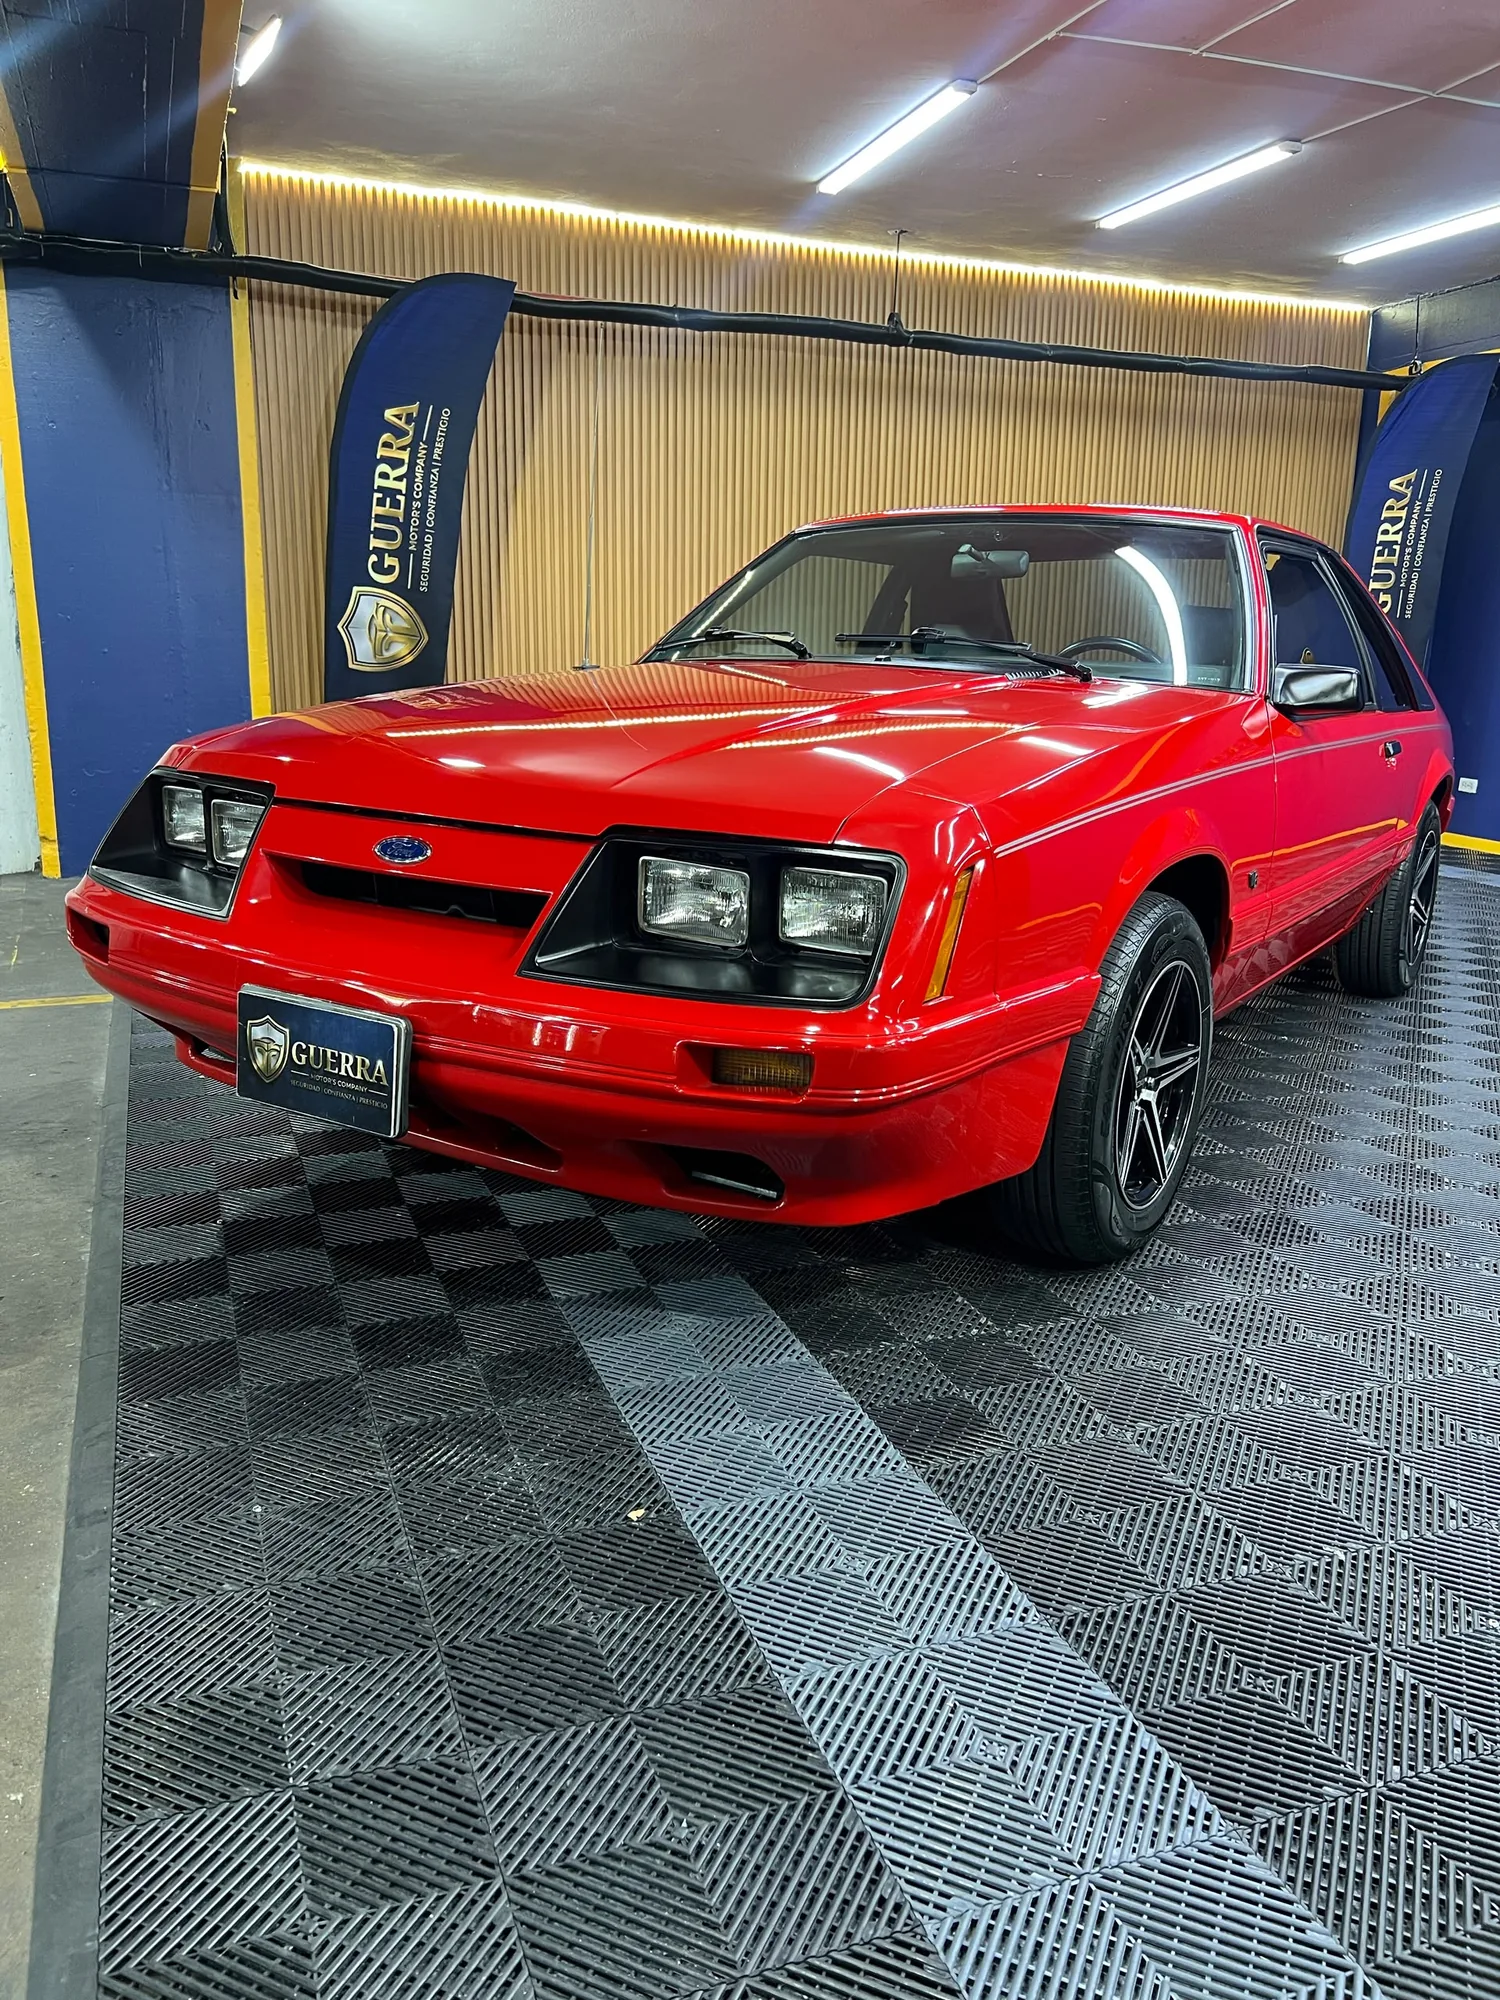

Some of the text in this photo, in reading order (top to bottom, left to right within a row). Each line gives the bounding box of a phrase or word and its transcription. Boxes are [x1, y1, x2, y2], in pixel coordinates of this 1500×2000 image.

[432, 407, 451, 460] PRESTIGIO
[367, 401, 420, 584] GUERRA
[408, 441, 428, 551] MOTOR'S COMPANY
[425, 467, 440, 527] CONFIANZA
[419, 534, 434, 593] SEGURIDAD
[1399, 500, 1423, 587] MOTOR'S COMPANY
[1404, 572, 1419, 619] SEGURIDAD
[1413, 517, 1430, 567] CONFIANZA
[1424, 468, 1443, 512] PRESTIGIO
[291, 1041, 389, 1087] GUERRA
[337, 1079, 368, 1093] COMPANY
